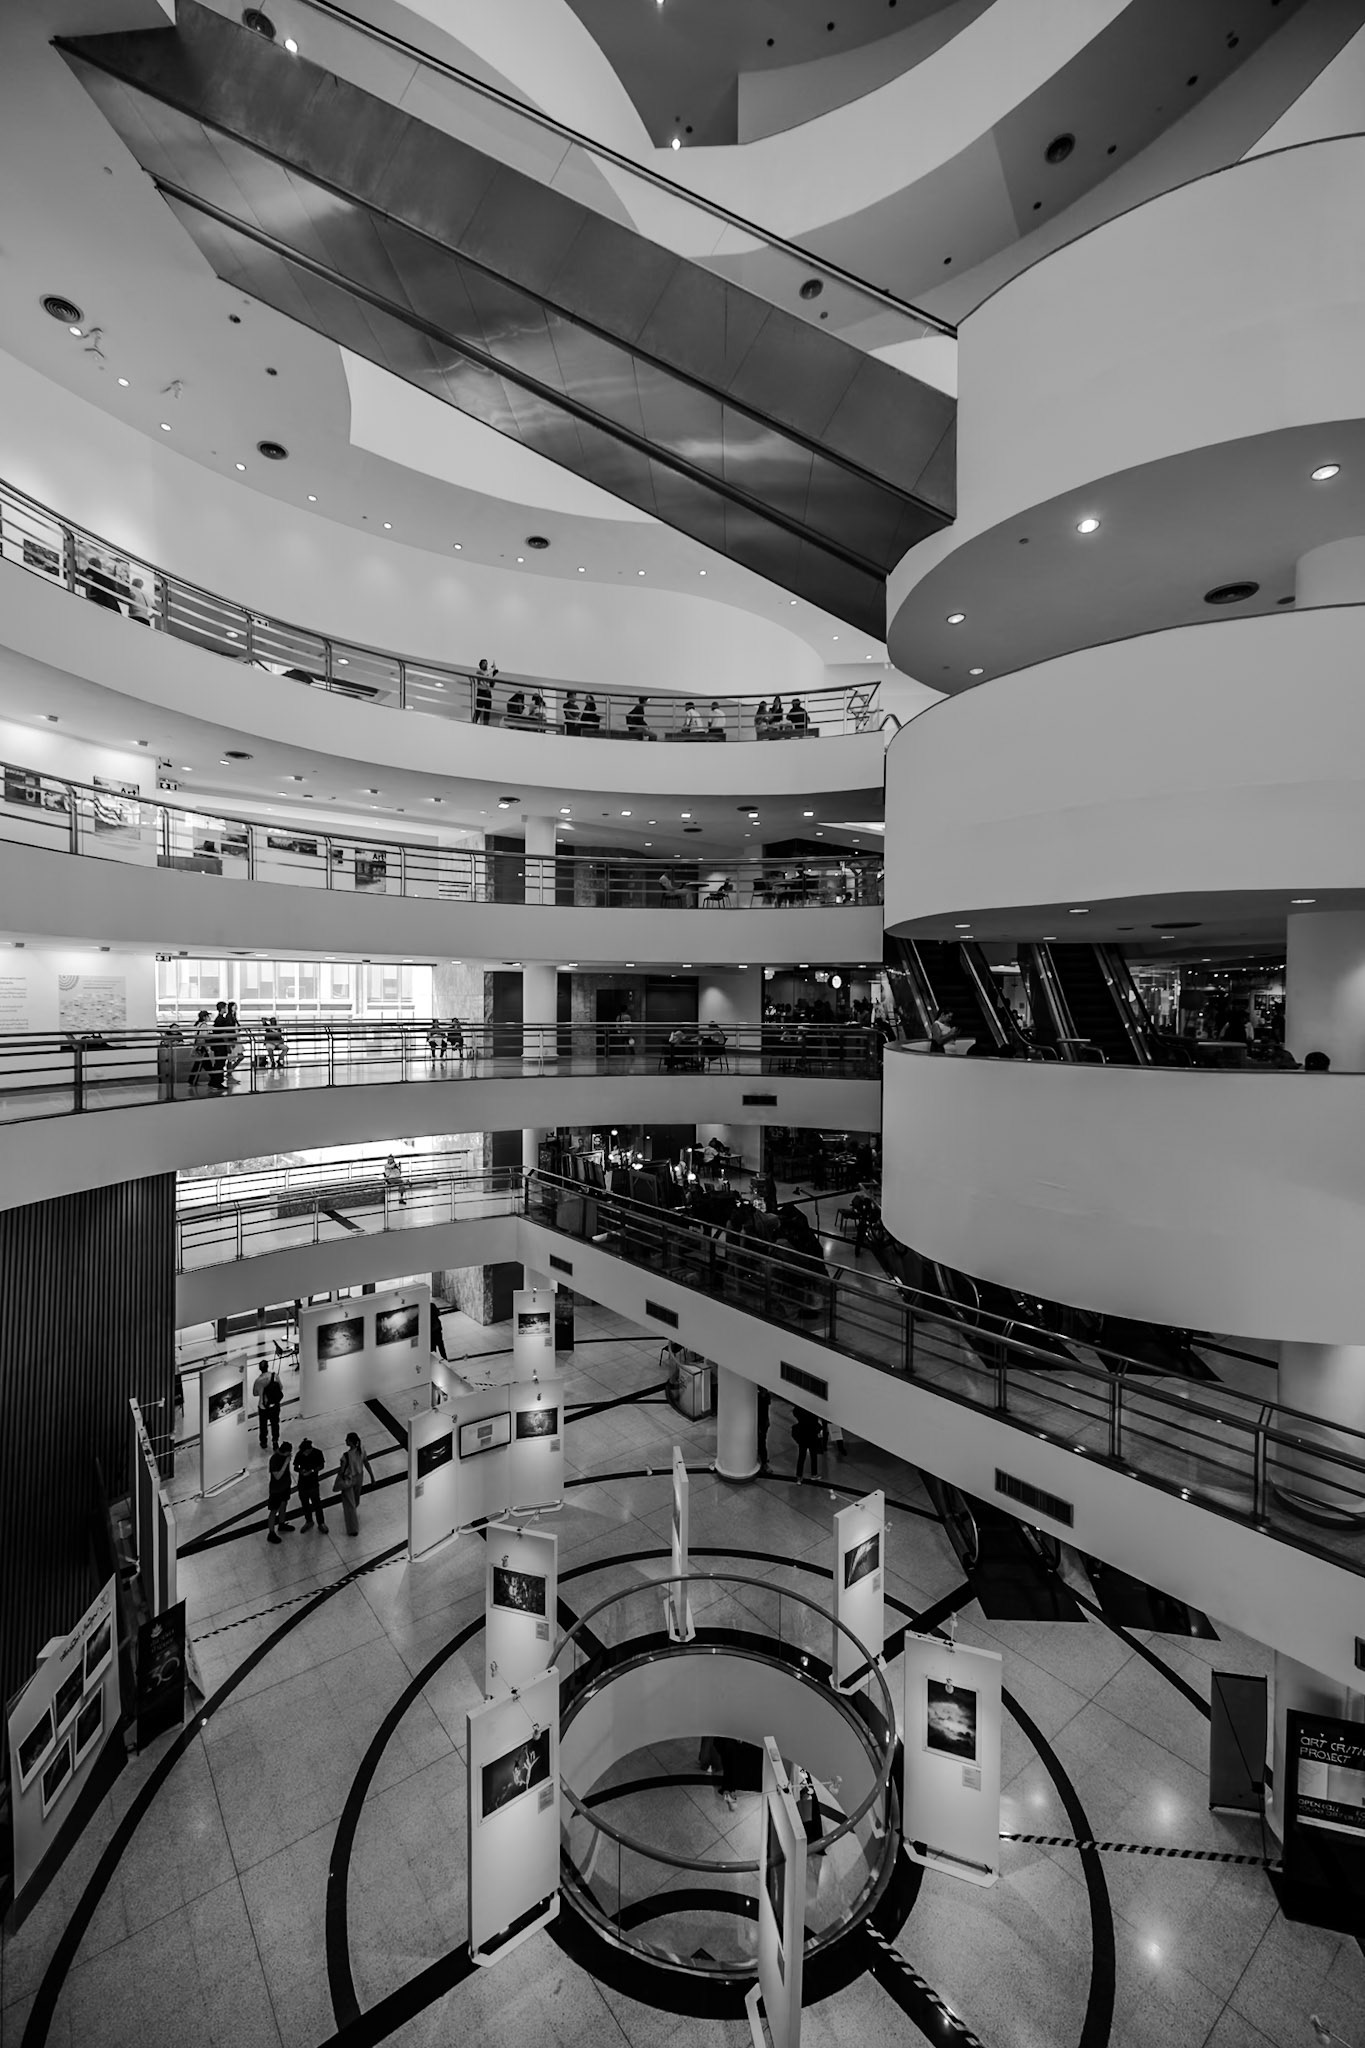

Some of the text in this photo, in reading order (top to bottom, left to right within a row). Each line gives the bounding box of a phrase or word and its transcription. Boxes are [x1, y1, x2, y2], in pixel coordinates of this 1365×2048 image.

[372, 853, 385, 861] Art
[1300, 1736, 1328, 1748] ART
[1300, 1746, 1352, 1764] PROJECT
